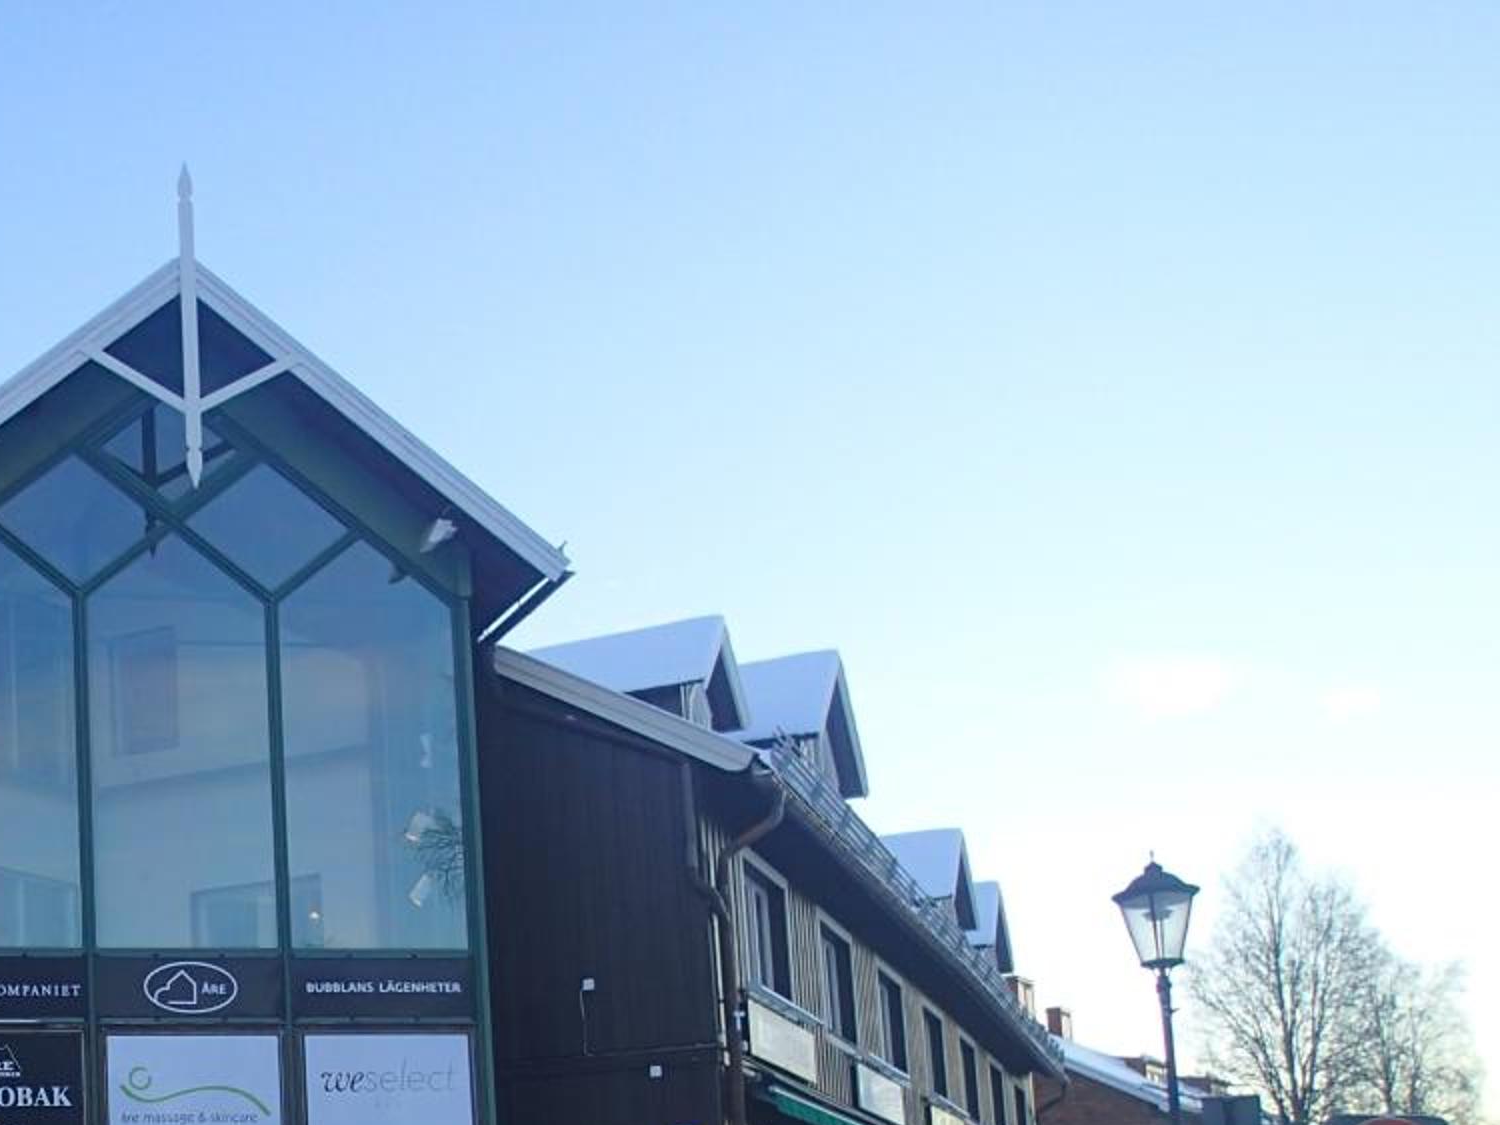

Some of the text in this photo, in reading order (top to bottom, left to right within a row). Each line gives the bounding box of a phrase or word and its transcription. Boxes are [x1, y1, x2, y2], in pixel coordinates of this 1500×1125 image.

[305, 980, 461, 993] BUBBLANS LÄGENHETER
[143, 1112, 195, 1125] massage
[210, 1111, 258, 1123] skincare
